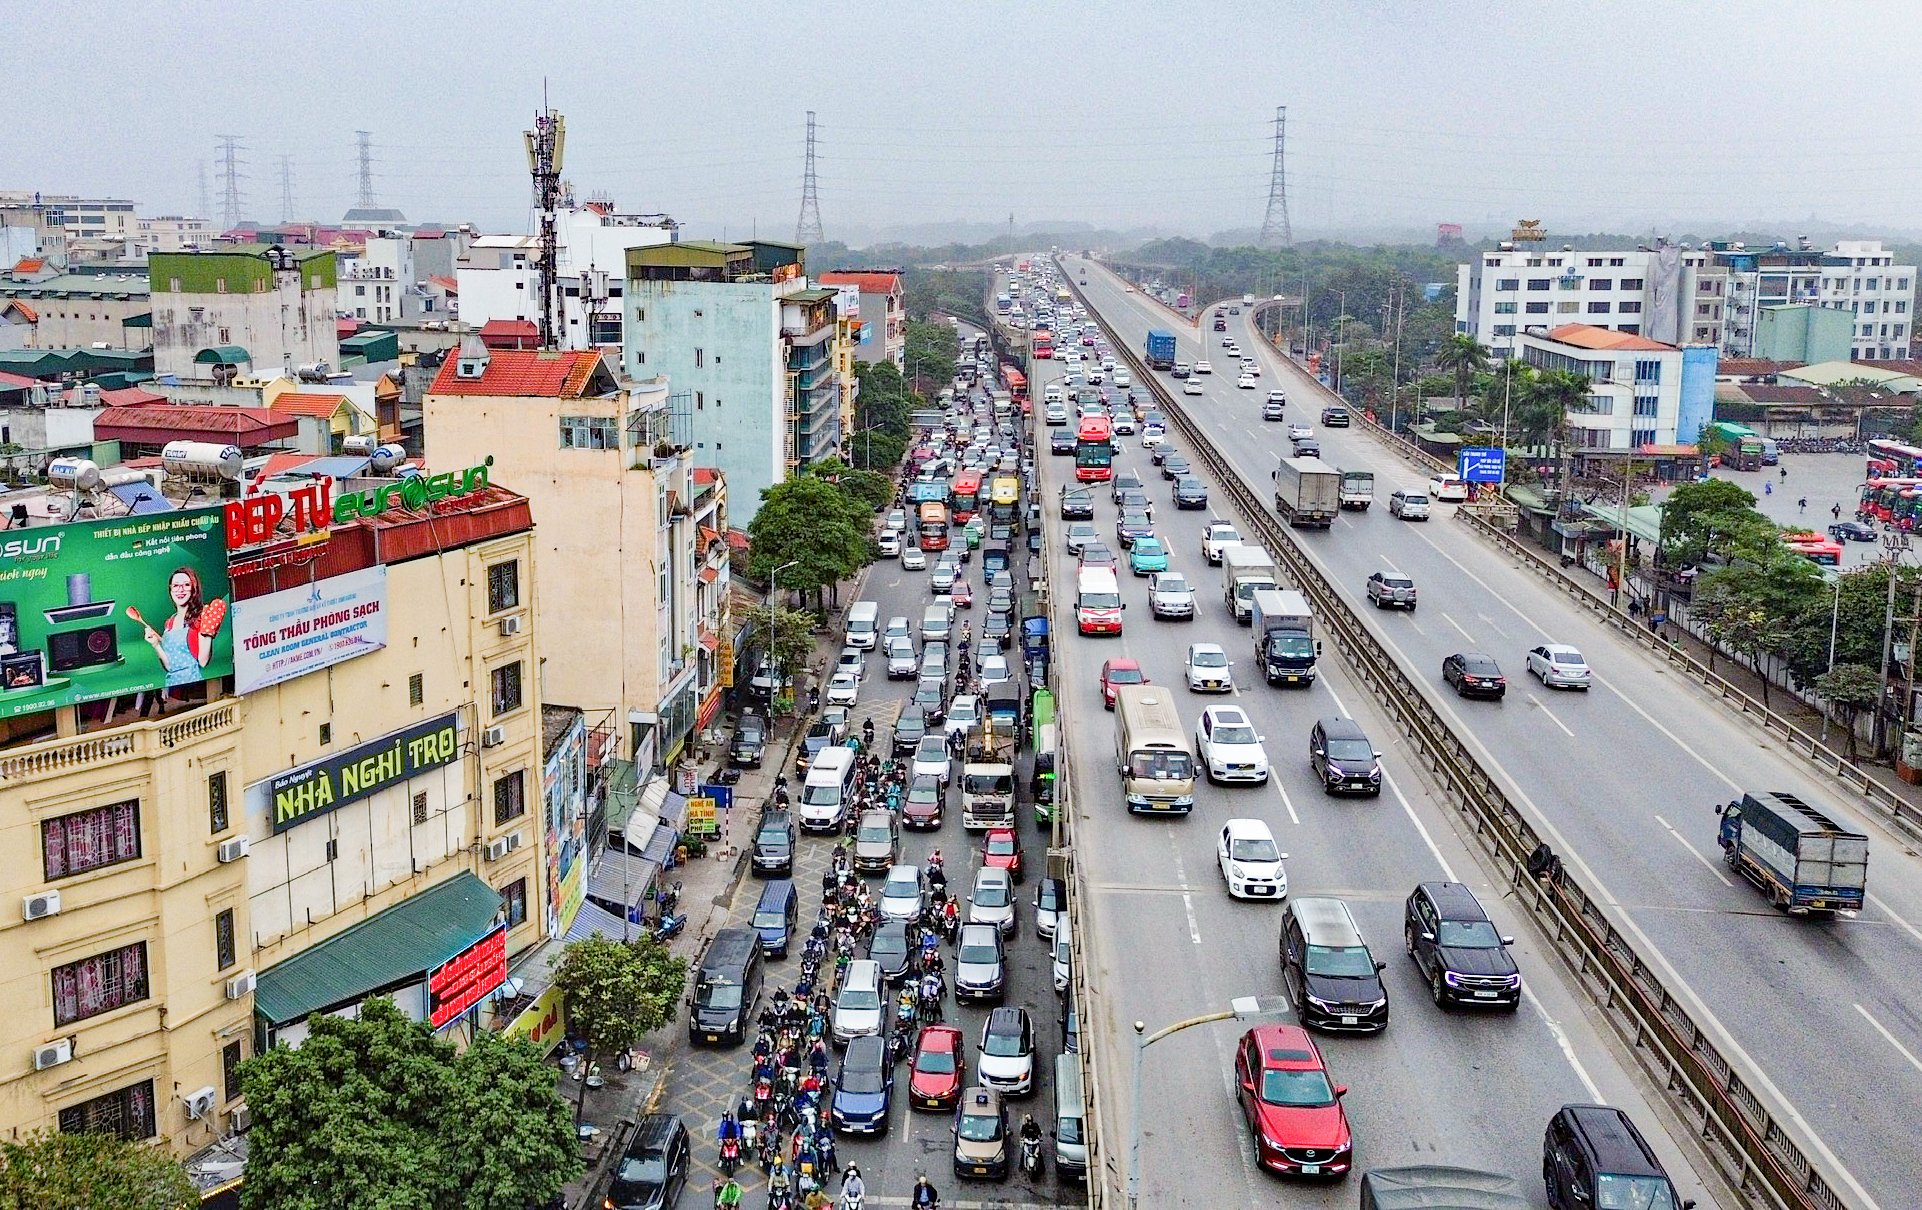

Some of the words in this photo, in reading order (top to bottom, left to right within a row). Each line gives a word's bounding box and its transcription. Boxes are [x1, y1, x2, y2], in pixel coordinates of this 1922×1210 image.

[94, 528, 112, 538] THIẾT
[114, 528, 121, 537] BỊ
[123, 526, 136, 536] NHÀ
[138, 522, 151, 533] BẾP
[153, 521, 170, 531] NHẬP
[191, 516, 208, 526] CHÂU
[224, 475, 283, 551] BẾP
[134, 547, 152, 557] công
[145, 537, 158, 547] Kết
[159, 535, 170, 544] nối
[185, 532, 207, 542] phong
[22, 567, 48, 581] ngay
[243, 631, 276, 651] TỔNG
[279, 619, 310, 640] THẦU
[313, 609, 350, 631] PHÒNG
[353, 600, 380, 619] SẠCH
[259, 647, 280, 660] CLEAN
[281, 642, 300, 653] ROOM
[301, 632, 329, 647] GENERAL
[330, 620, 368, 639] CONTRACTOR
[276, 770, 334, 824] NHÀ
[341, 739, 402, 798] NGHỈ
[408, 727, 454, 769] TRỌ
